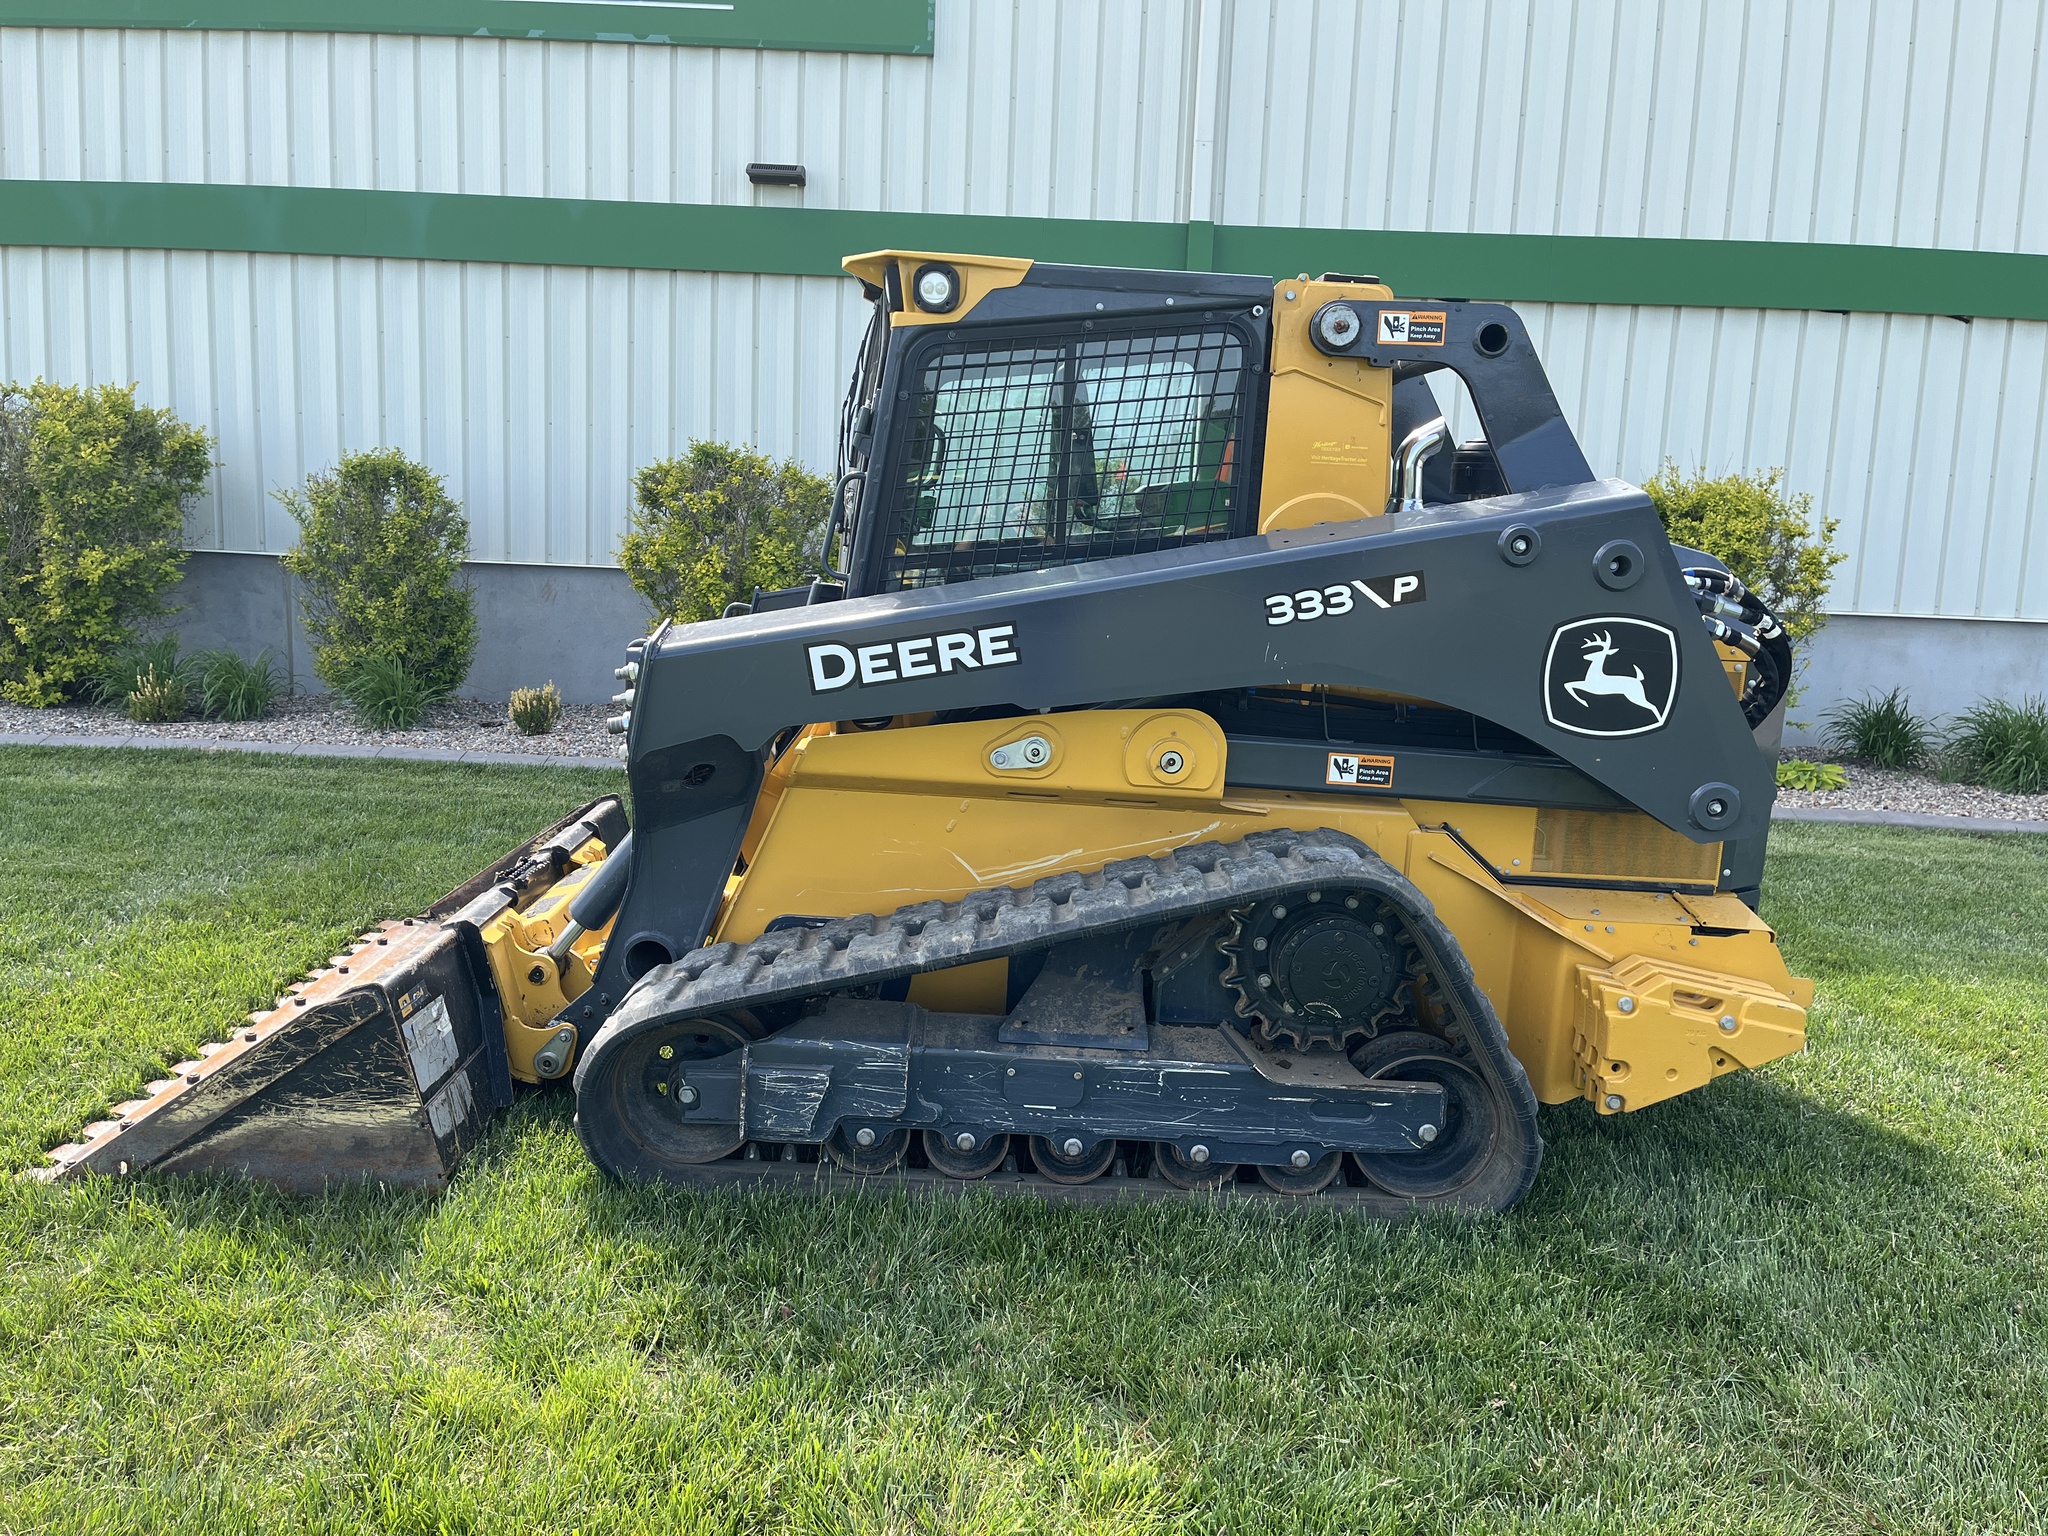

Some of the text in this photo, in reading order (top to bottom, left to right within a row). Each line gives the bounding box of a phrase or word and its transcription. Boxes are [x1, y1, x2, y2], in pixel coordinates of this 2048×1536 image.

[1265, 575, 1419, 626] 333 P
[808, 625, 1018, 691] DEERE
[1334, 945, 1367, 974] SPICER
